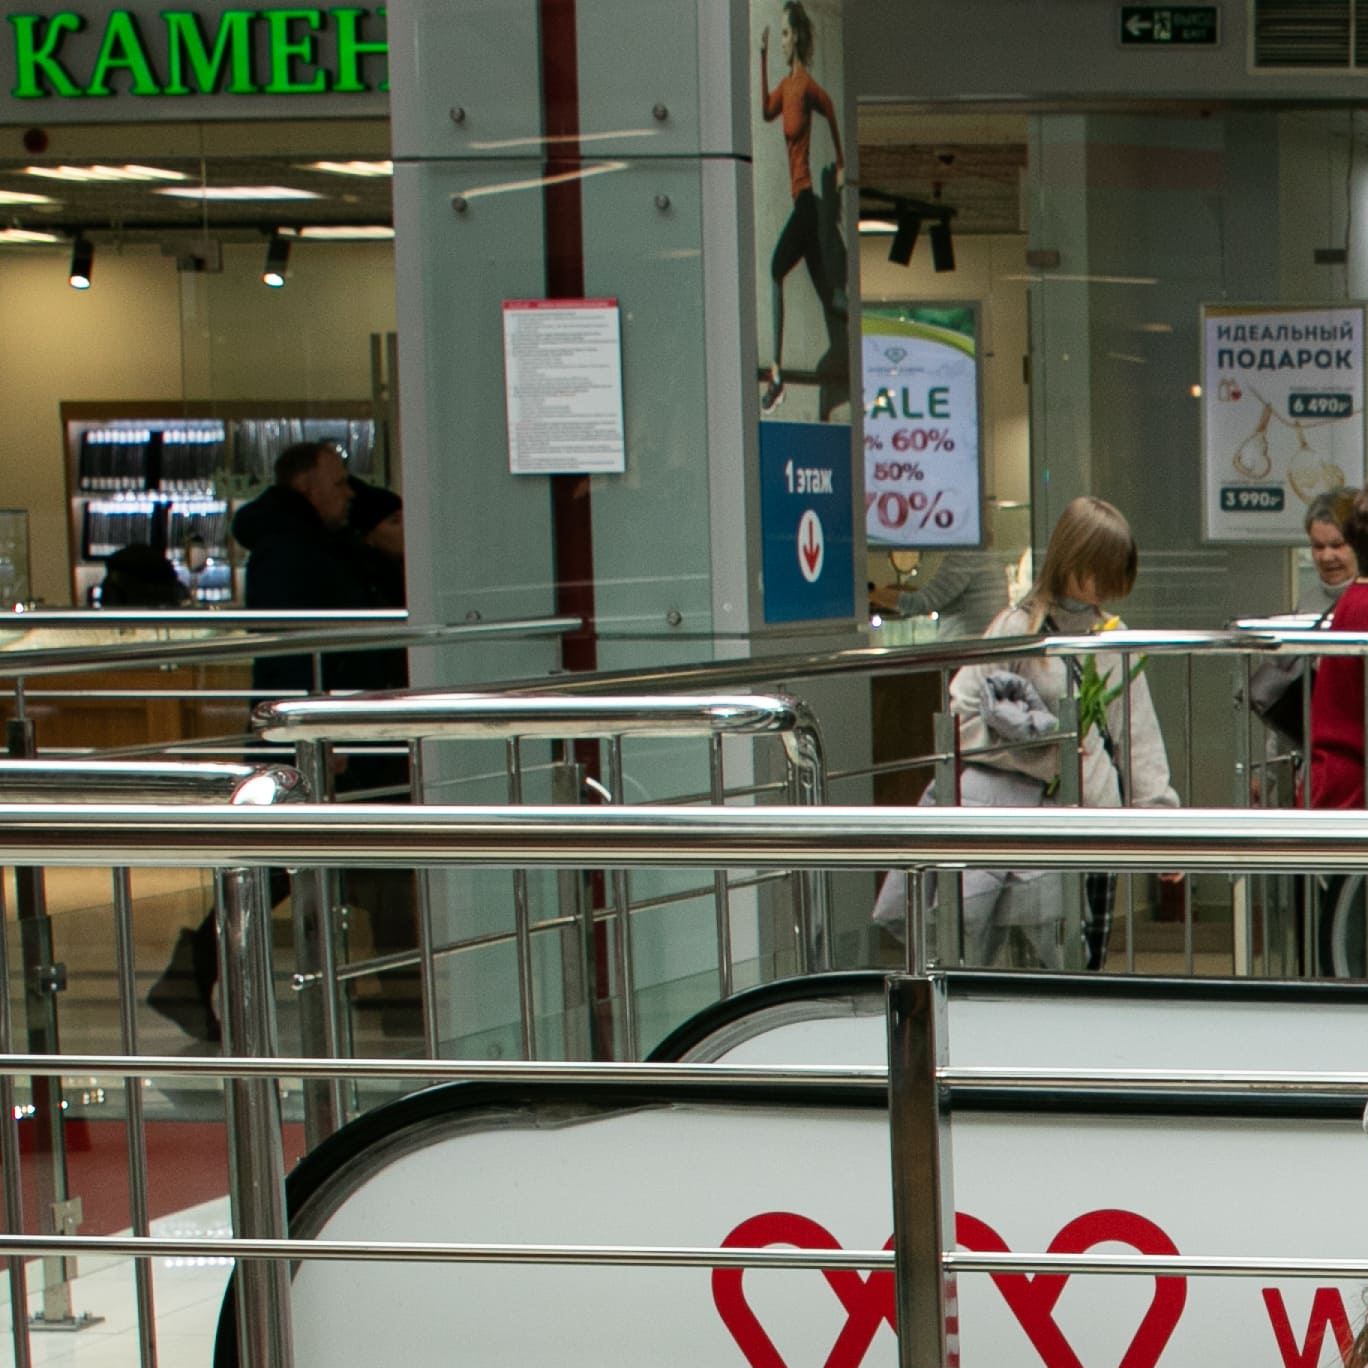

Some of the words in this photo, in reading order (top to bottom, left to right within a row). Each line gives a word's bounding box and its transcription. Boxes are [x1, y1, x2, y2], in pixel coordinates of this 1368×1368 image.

[1217, 321, 1354, 343] ИДЕАЛЬНЫЙ
[1217, 349, 1353, 371] ПОДАРОК
[863, 386, 951, 420] ALE
[891, 428, 955, 453] 60%
[785, 459, 794, 494] 1
[797, 466, 834, 494] этаж
[874, 462, 925, 482] 50%
[1225, 491, 1236, 506] 3
